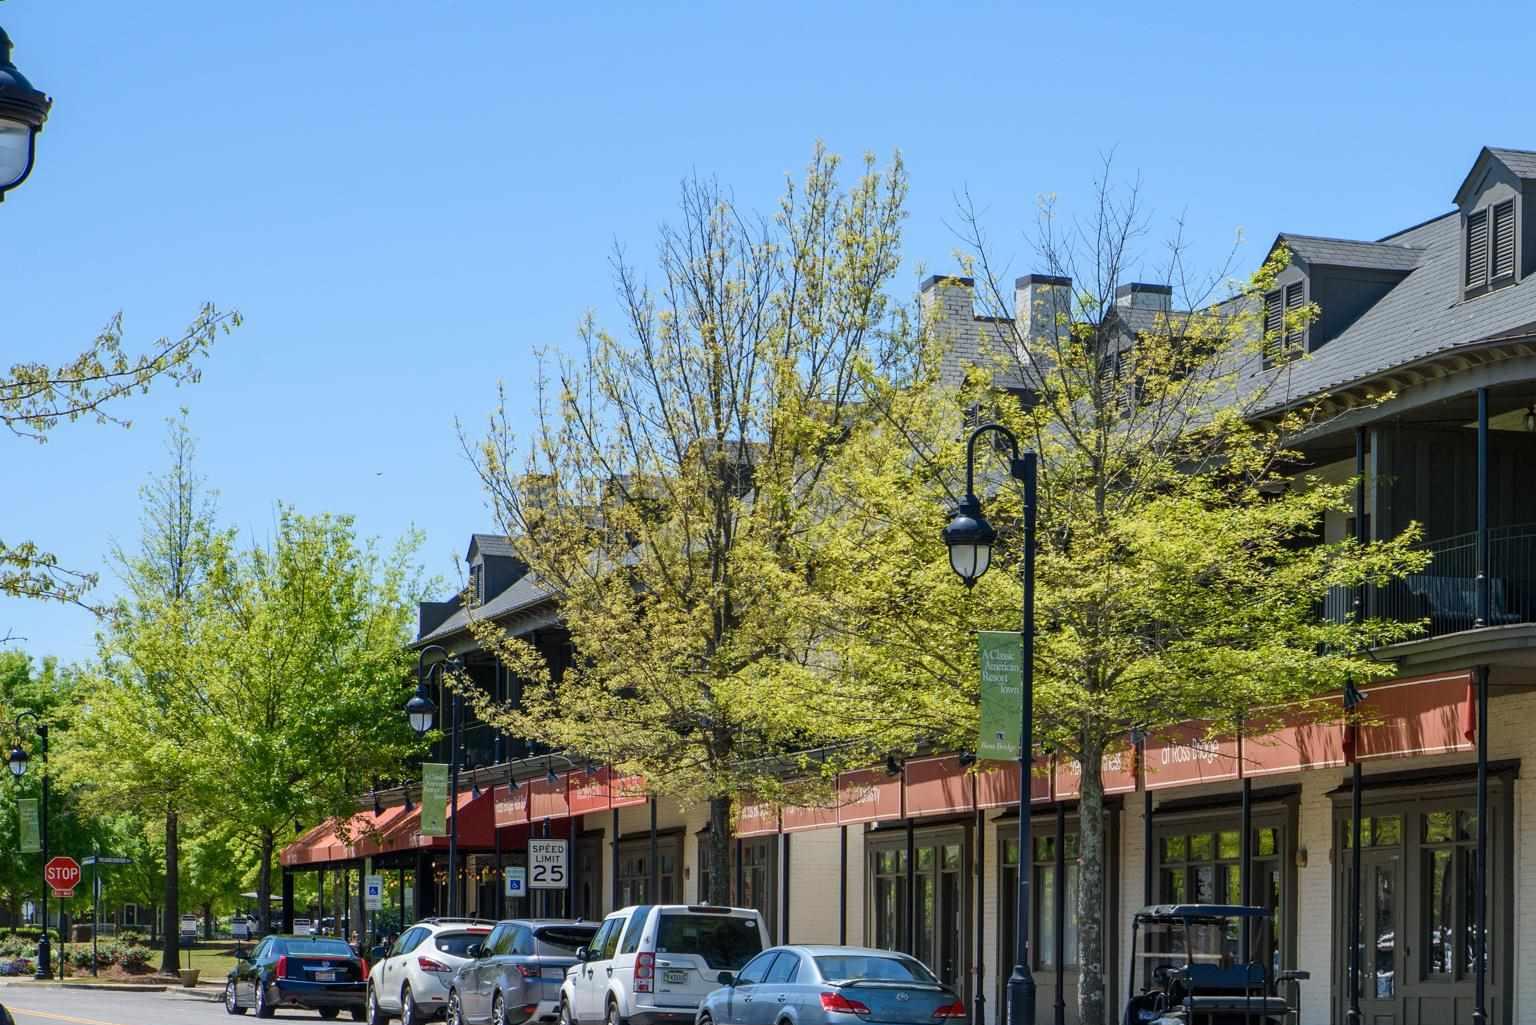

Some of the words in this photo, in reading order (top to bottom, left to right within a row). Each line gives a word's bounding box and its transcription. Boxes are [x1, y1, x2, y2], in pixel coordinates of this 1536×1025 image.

[989, 649, 1014, 661] Classic
[985, 661, 1019, 673] American
[982, 672, 1008, 683] Resort
[1000, 685, 1019, 696] Town
[532, 845, 564, 854] SPEED
[535, 855, 561, 864] LIMIT
[47, 867, 78, 880] STOP
[533, 864, 564, 882] 25
